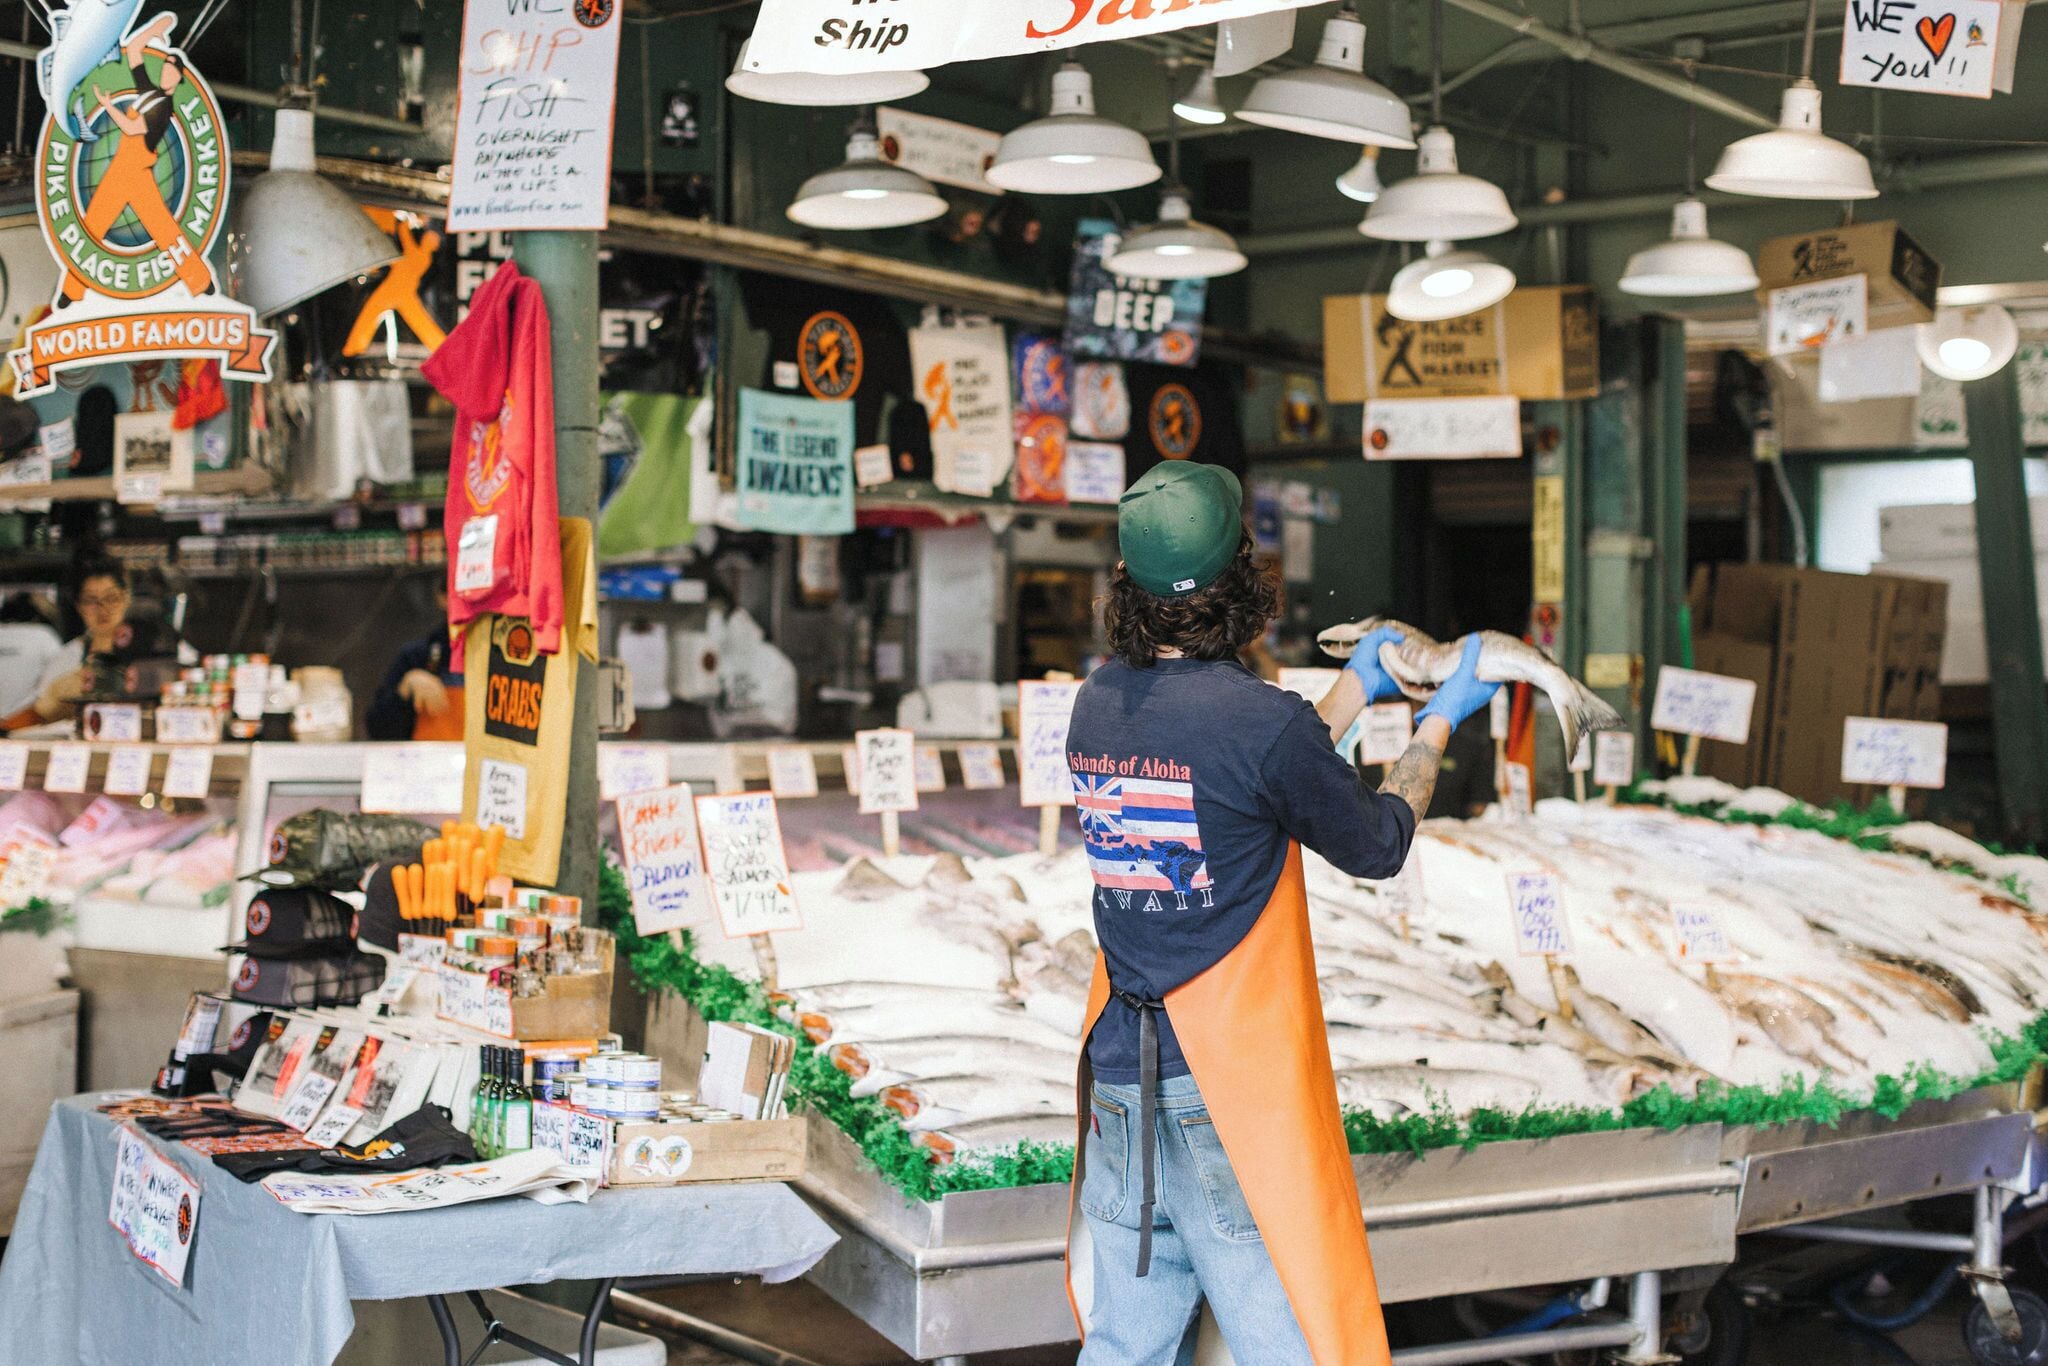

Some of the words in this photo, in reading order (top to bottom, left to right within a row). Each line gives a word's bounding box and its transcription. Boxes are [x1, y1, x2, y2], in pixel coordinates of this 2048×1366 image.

[1852, 0, 1916, 34] WE
[814, 18, 909, 55] Ship
[475, 128, 595, 146] OVERNIGHT
[474, 146, 567, 168] ANYWHERE
[496, 168, 523, 179] THE
[47, 141, 69, 221] PIKE
[59, 222, 129, 289] PLACE
[137, 234, 194, 290] FISH
[187, 95, 219, 239] MARKET
[1093, 289, 1176, 333] DEEP
[36, 322, 126, 358] WORLD
[131, 317, 245, 346] FAMOUS
[752, 427, 779, 454] THE
[785, 430, 839, 460] LEGEND
[748, 457, 846, 499] AWAKENS
[488, 673, 542, 731] CRABS
[1069, 751, 1116, 775] Islands
[1119, 756, 1138, 775] of
[1140, 757, 1192, 781] Aloha
